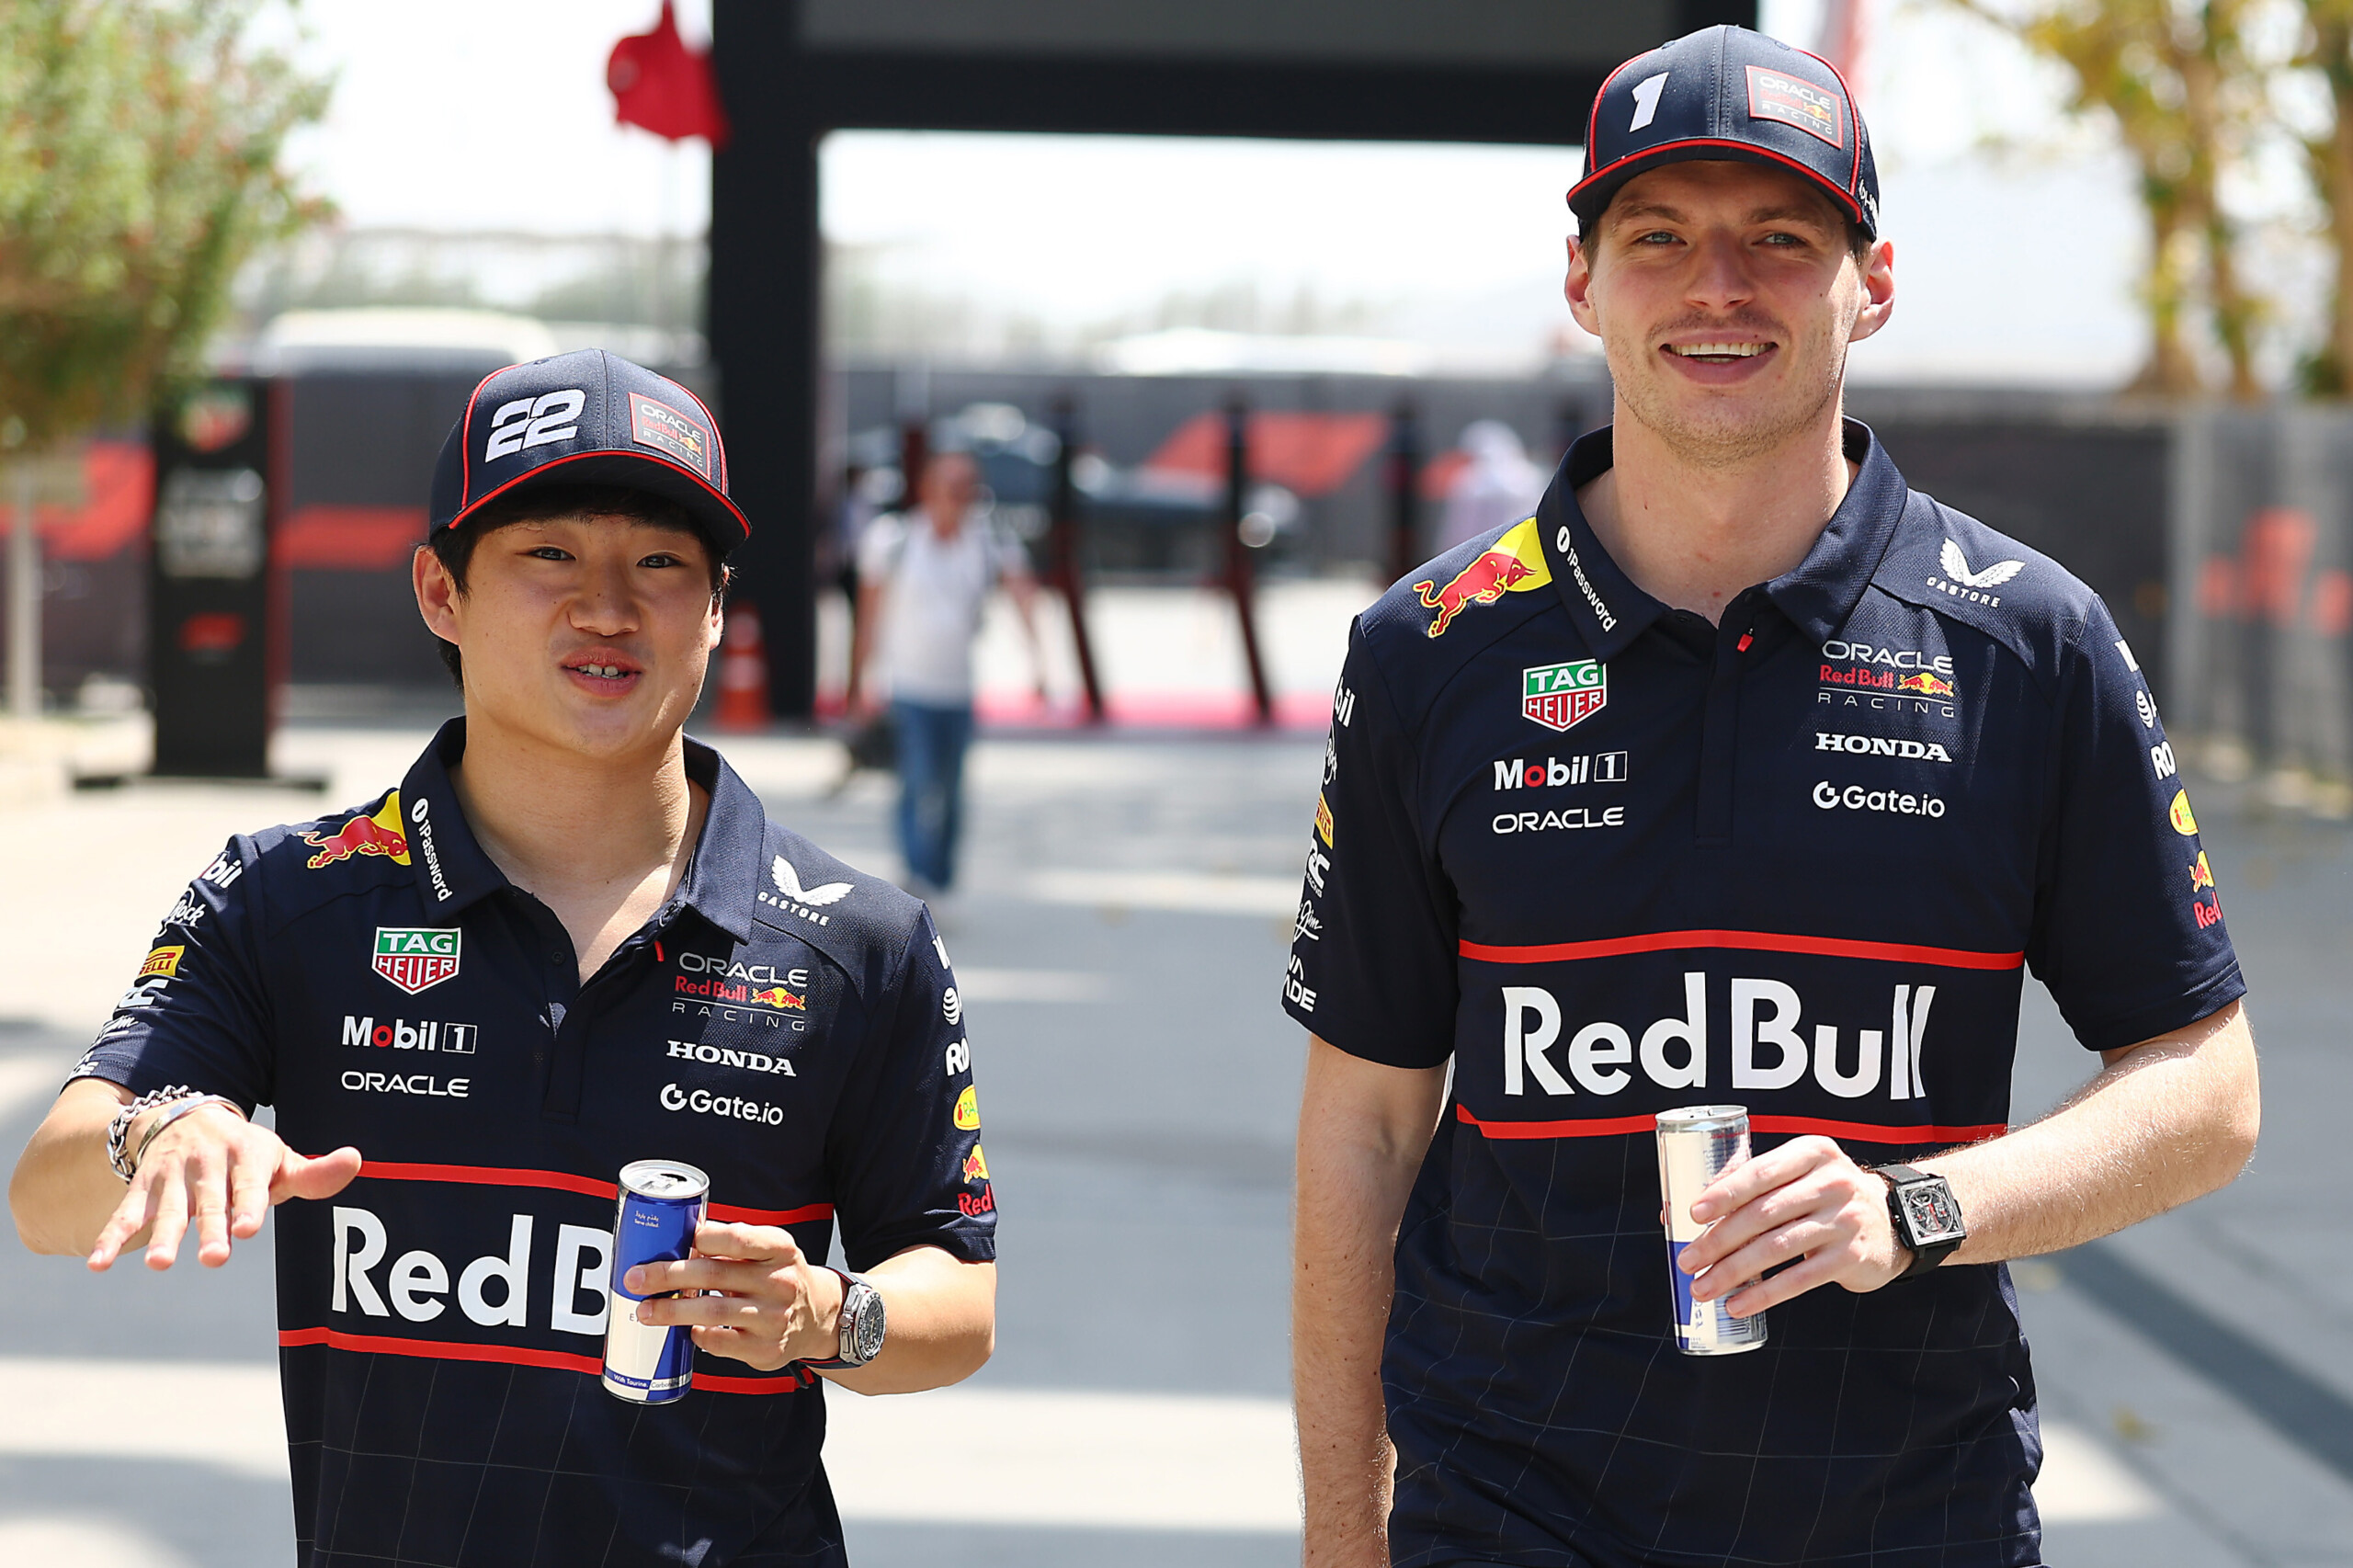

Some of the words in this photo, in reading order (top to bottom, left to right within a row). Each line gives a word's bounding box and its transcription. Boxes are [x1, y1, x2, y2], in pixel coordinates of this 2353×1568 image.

[1629, 72, 1669, 132] 1
[1759, 76, 1831, 110] ORACLE
[1762, 103, 1832, 134] RACING
[484, 389, 586, 463] 22
[642, 404, 701, 443] ORACLE
[643, 430, 703, 467] RACING
[1566, 549, 1617, 632] 1Password
[1926, 576, 2000, 608] CASTORE
[1822, 640, 1954, 674] ORACLE
[1530, 664, 1598, 692] TAG
[1819, 664, 1856, 685] Red
[1858, 669, 1894, 688] Bull
[1528, 690, 1601, 729] HEUER
[1817, 692, 1955, 718] RACING
[1814, 732, 1952, 763] HONDA
[1494, 756, 1589, 790] Mobil
[1843, 785, 1946, 818] Gate.io
[1492, 806, 1625, 835] ORACLE
[418, 818, 452, 903] 1Password
[757, 891, 829, 927] CASTORE
[2193, 891, 2223, 929] Red
[382, 933, 453, 954] TAG
[377, 957, 453, 990] HEUER
[678, 952, 809, 988] ORACLE
[675, 975, 710, 995] Red
[711, 981, 747, 1003] Bull
[342, 1016, 438, 1051] Mobil
[672, 1002, 805, 1031] RACING
[1501, 971, 1707, 1096] Red
[1731, 978, 1936, 1100] Bull
[666, 1040, 797, 1077] HONDA
[341, 1071, 471, 1097] ORACLE
[689, 1089, 784, 1126] Gate.io
[958, 1183, 993, 1216] Red
[332, 1206, 533, 1327] Red
